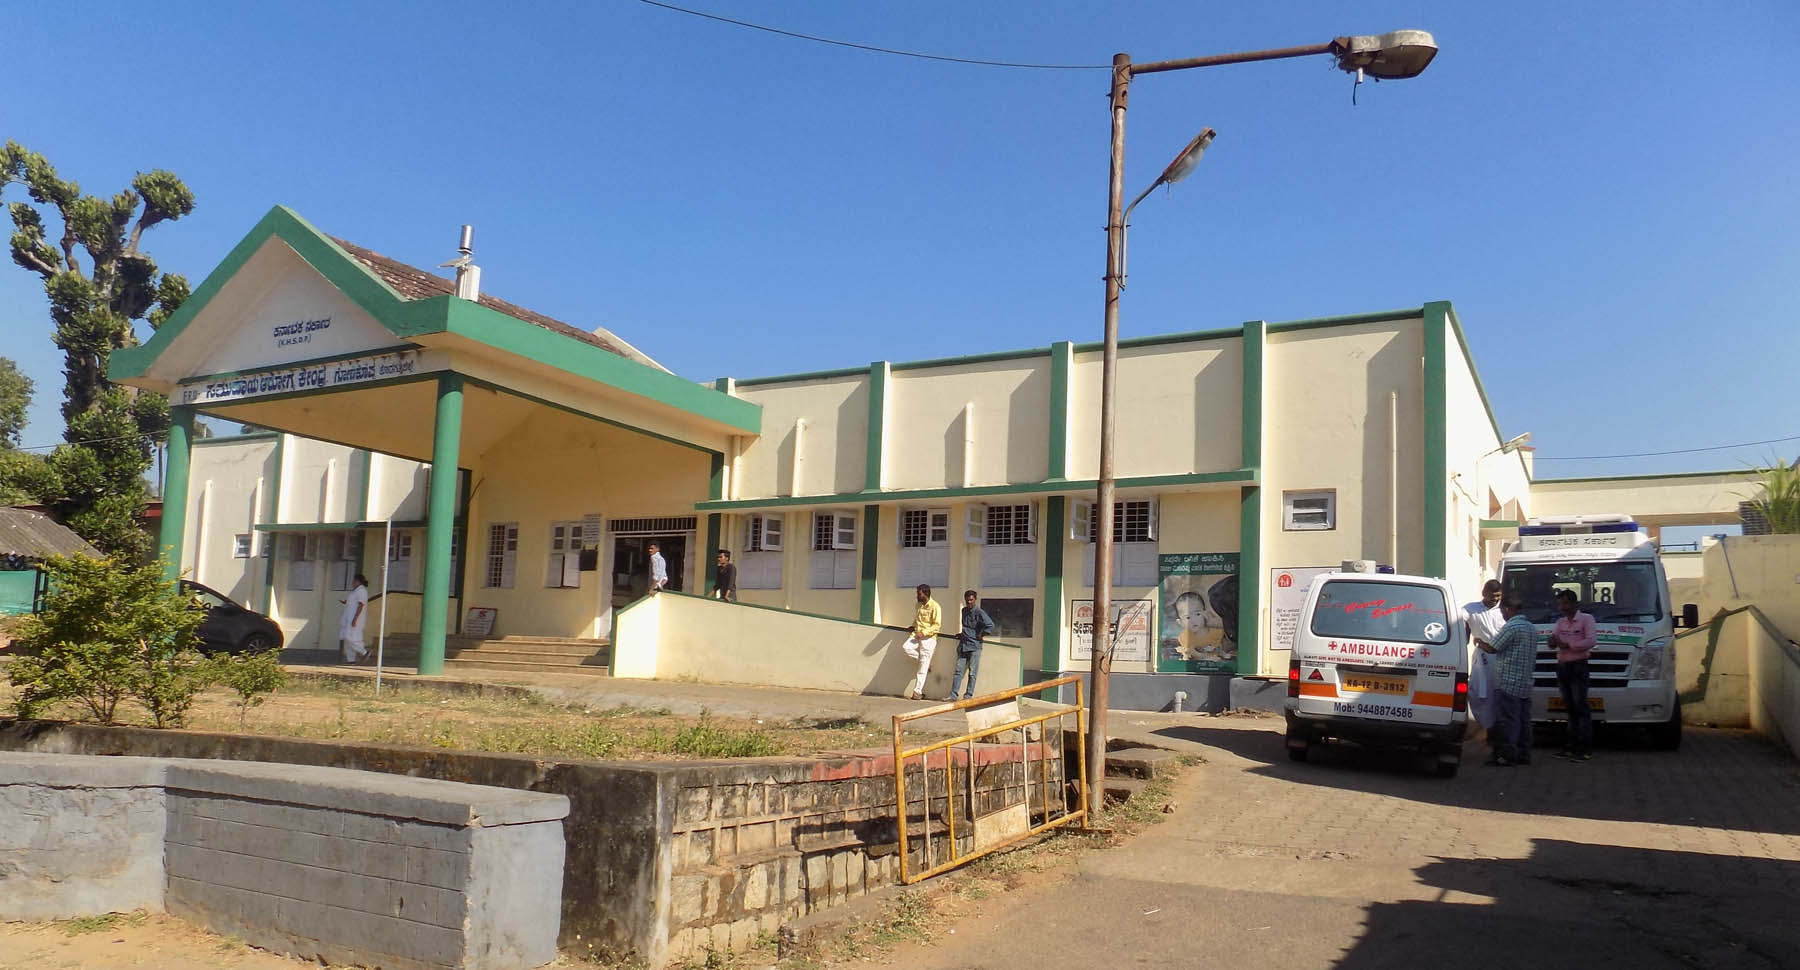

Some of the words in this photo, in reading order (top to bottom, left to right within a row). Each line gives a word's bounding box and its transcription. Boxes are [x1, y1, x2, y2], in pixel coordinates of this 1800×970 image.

[1539, 538, 1578, 547] ಕರ್ನಾಟಕ
[1584, 537, 1617, 545] ಸರ್ಕಾರ
[1340, 643, 1415, 659] AMBULANCE
[1346, 679, 1371, 689] KA-12
[1334, 702, 1355, 713] Mob:
[1357, 704, 1413, 718] 9448874586
